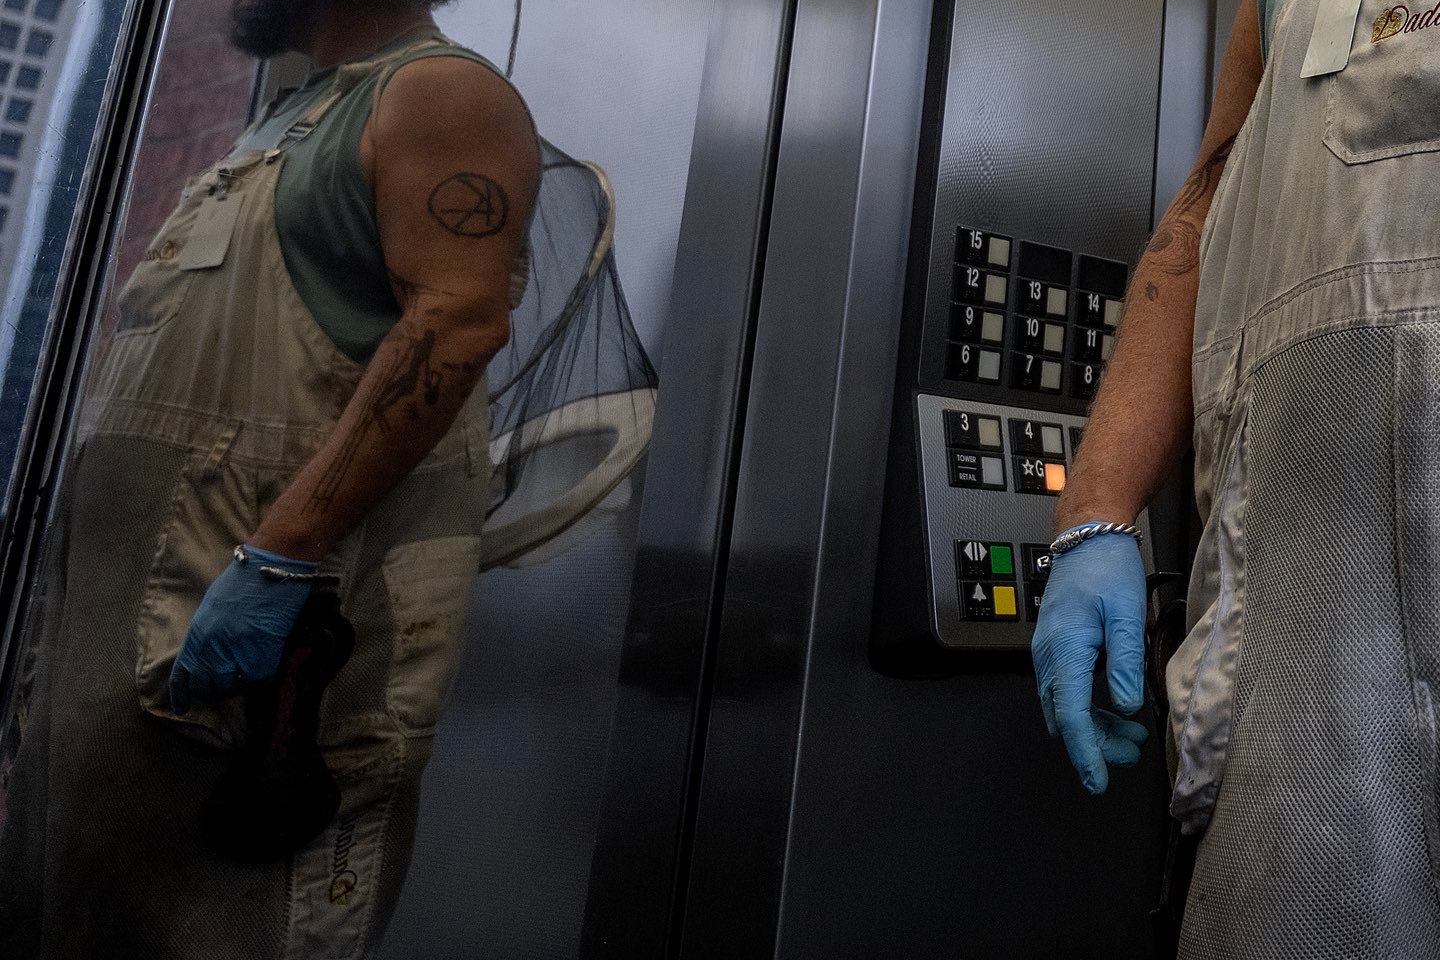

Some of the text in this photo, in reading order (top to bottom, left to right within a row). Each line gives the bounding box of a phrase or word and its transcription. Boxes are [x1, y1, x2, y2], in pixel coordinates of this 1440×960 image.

[969, 229, 983, 250] 15
[966, 267, 980, 288] 12
[1029, 280, 1042, 301] 13
[1087, 293, 1100, 313] 14
[965, 306, 974, 326] 9
[1026, 318, 1039, 338] 10
[1086, 329, 1097, 348] 11
[961, 344, 971, 365] 6
[1026, 354, 1034, 374] 7
[1084, 365, 1093, 384] 8
[961, 413, 969, 431] 3
[1025, 422, 1034, 439] 4
[956, 454, 977, 464] TOWER
[1035, 459, 1045, 478] G
[959, 472, 977, 482] RETAIL
